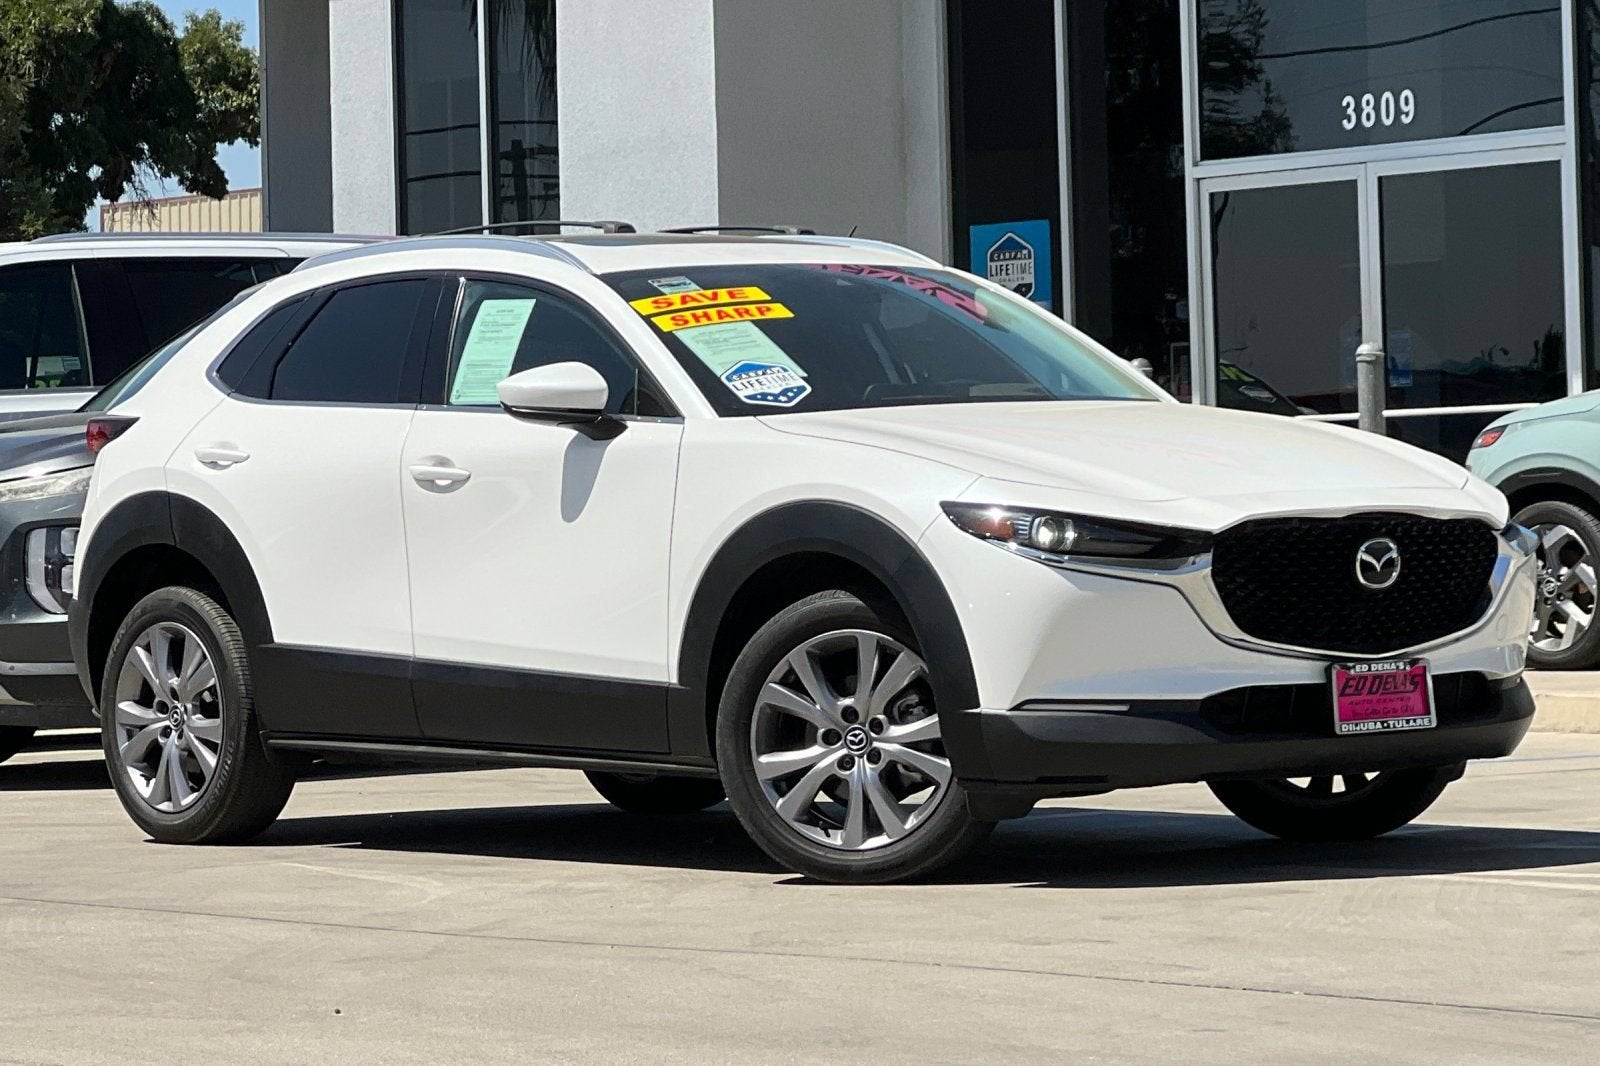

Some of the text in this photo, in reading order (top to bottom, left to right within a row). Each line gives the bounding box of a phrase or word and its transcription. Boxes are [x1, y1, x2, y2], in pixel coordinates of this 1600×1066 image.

[1341, 88, 1415, 130] 3809
[989, 261, 1033, 277] LIFETIME
[651, 288, 749, 309] SAVE
[670, 305, 773, 327] SHARP
[732, 373, 797, 391] LIFETIME
[1355, 662, 1405, 672] ED DENA'S
[1388, 718, 1431, 728] TULARE
